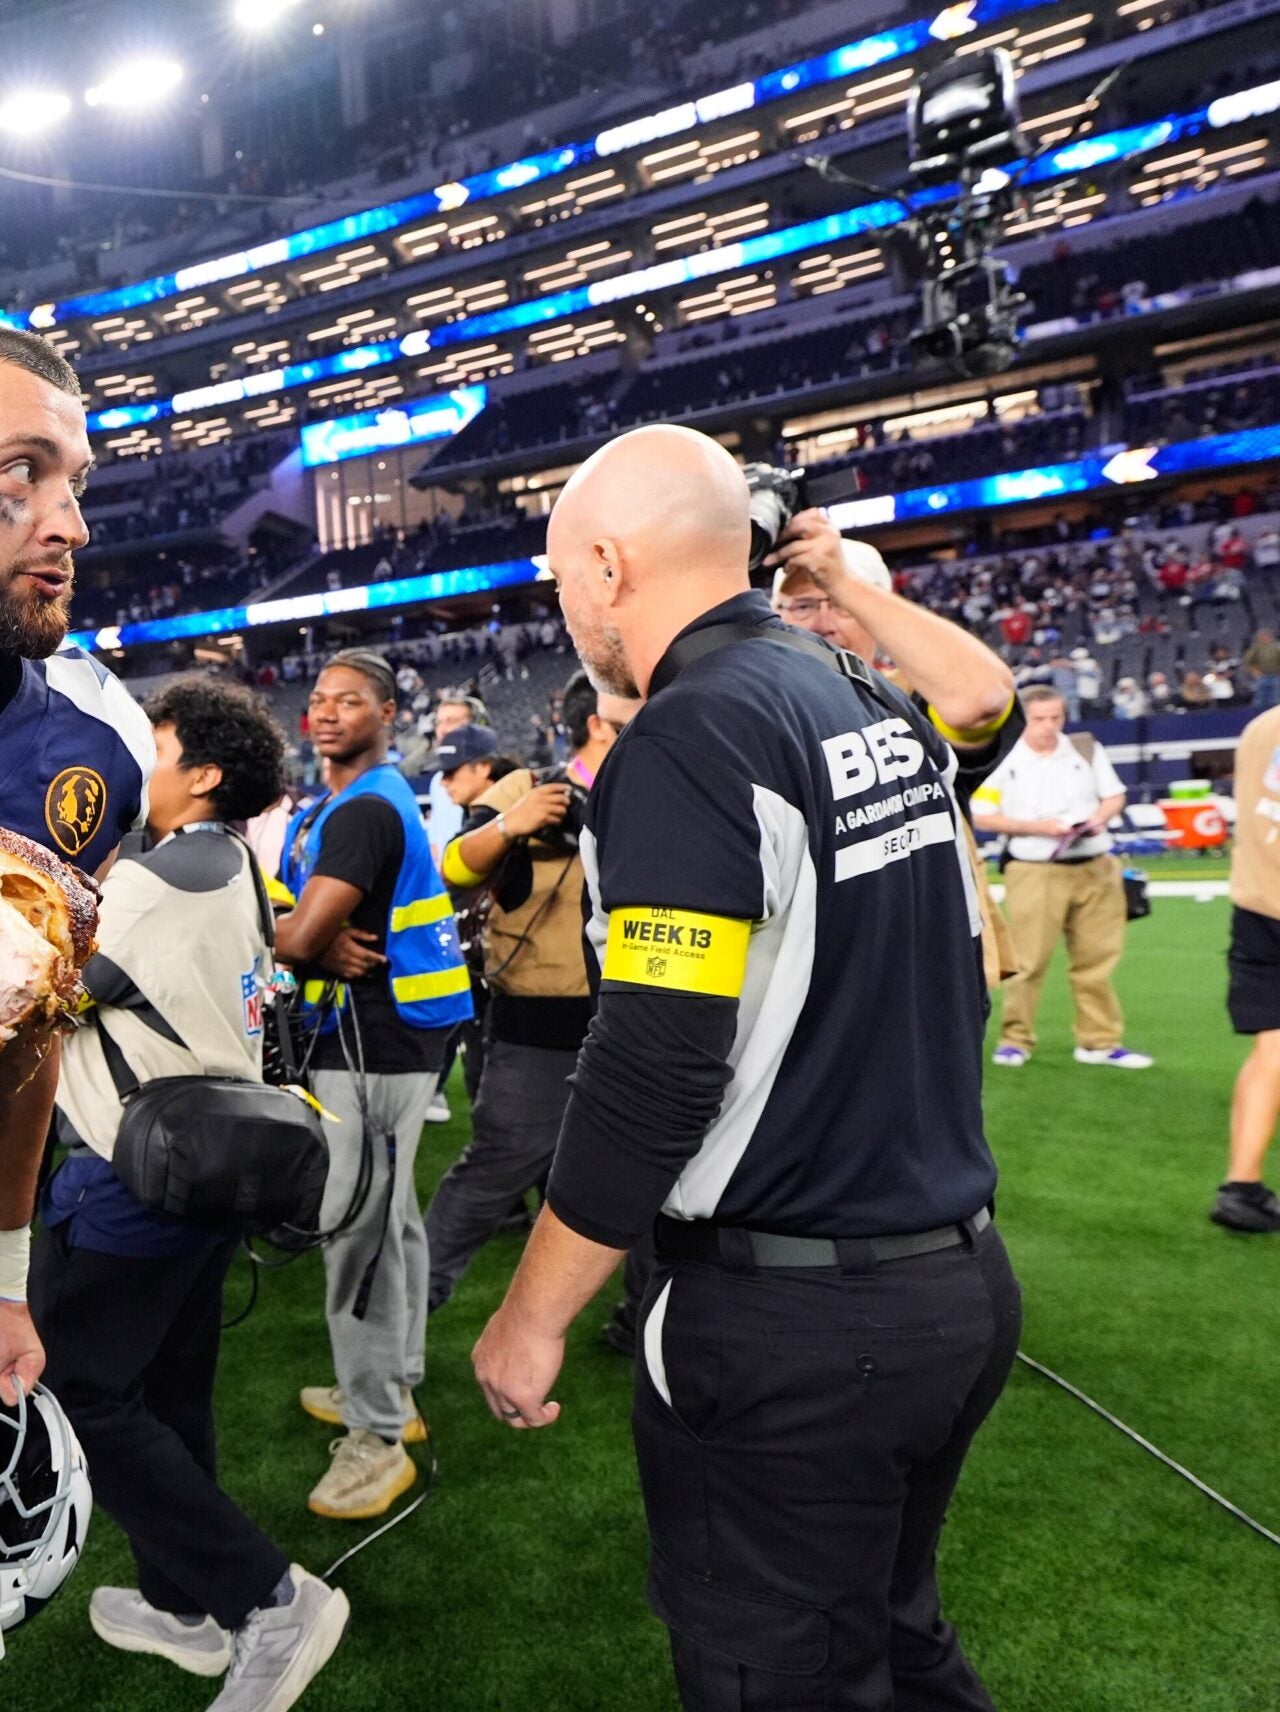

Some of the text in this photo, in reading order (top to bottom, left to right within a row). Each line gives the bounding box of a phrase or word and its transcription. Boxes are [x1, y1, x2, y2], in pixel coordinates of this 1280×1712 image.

[820, 717, 938, 801] BES
[835, 815, 848, 836] A
[651, 907, 676, 920] DAL
[623, 919, 713, 949] WEEK 13
[650, 945, 671, 956] Field
[673, 948, 706, 960] Access
